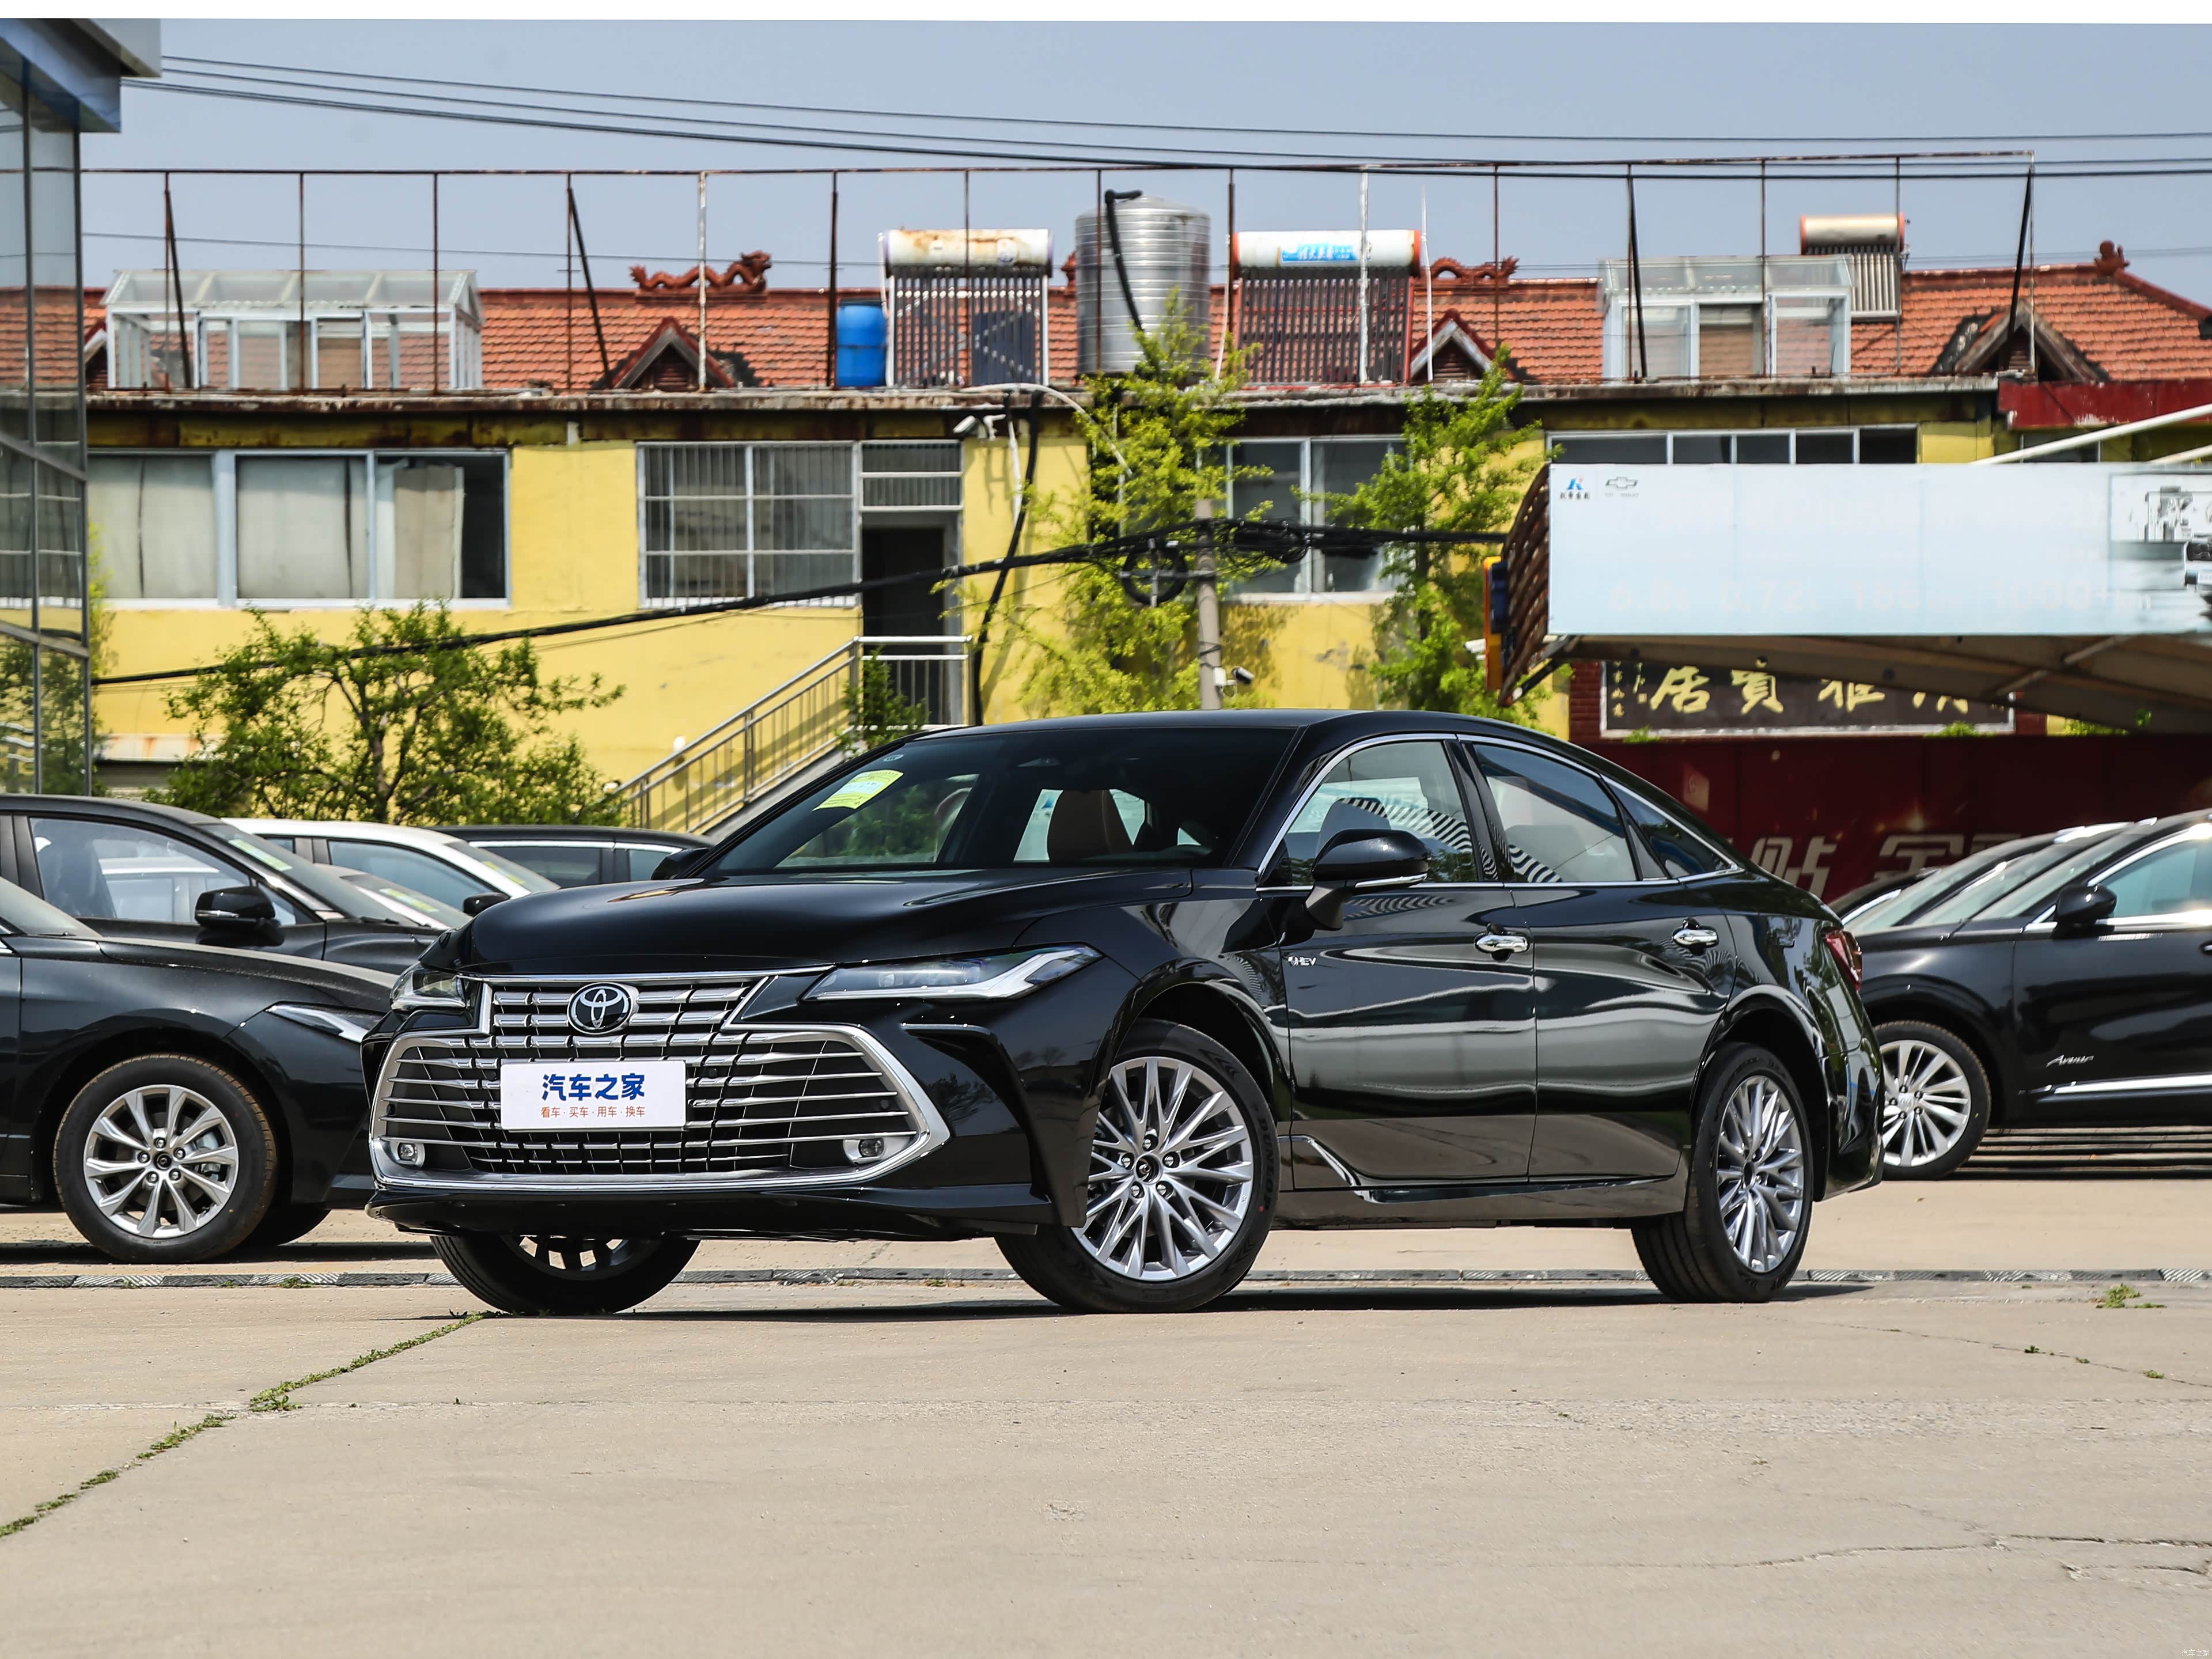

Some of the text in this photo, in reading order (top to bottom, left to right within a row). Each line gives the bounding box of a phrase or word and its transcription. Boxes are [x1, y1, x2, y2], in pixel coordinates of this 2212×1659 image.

[541, 1073, 645, 1101] 汽车之家
[1258, 1118, 1275, 1211] DUNLOP
